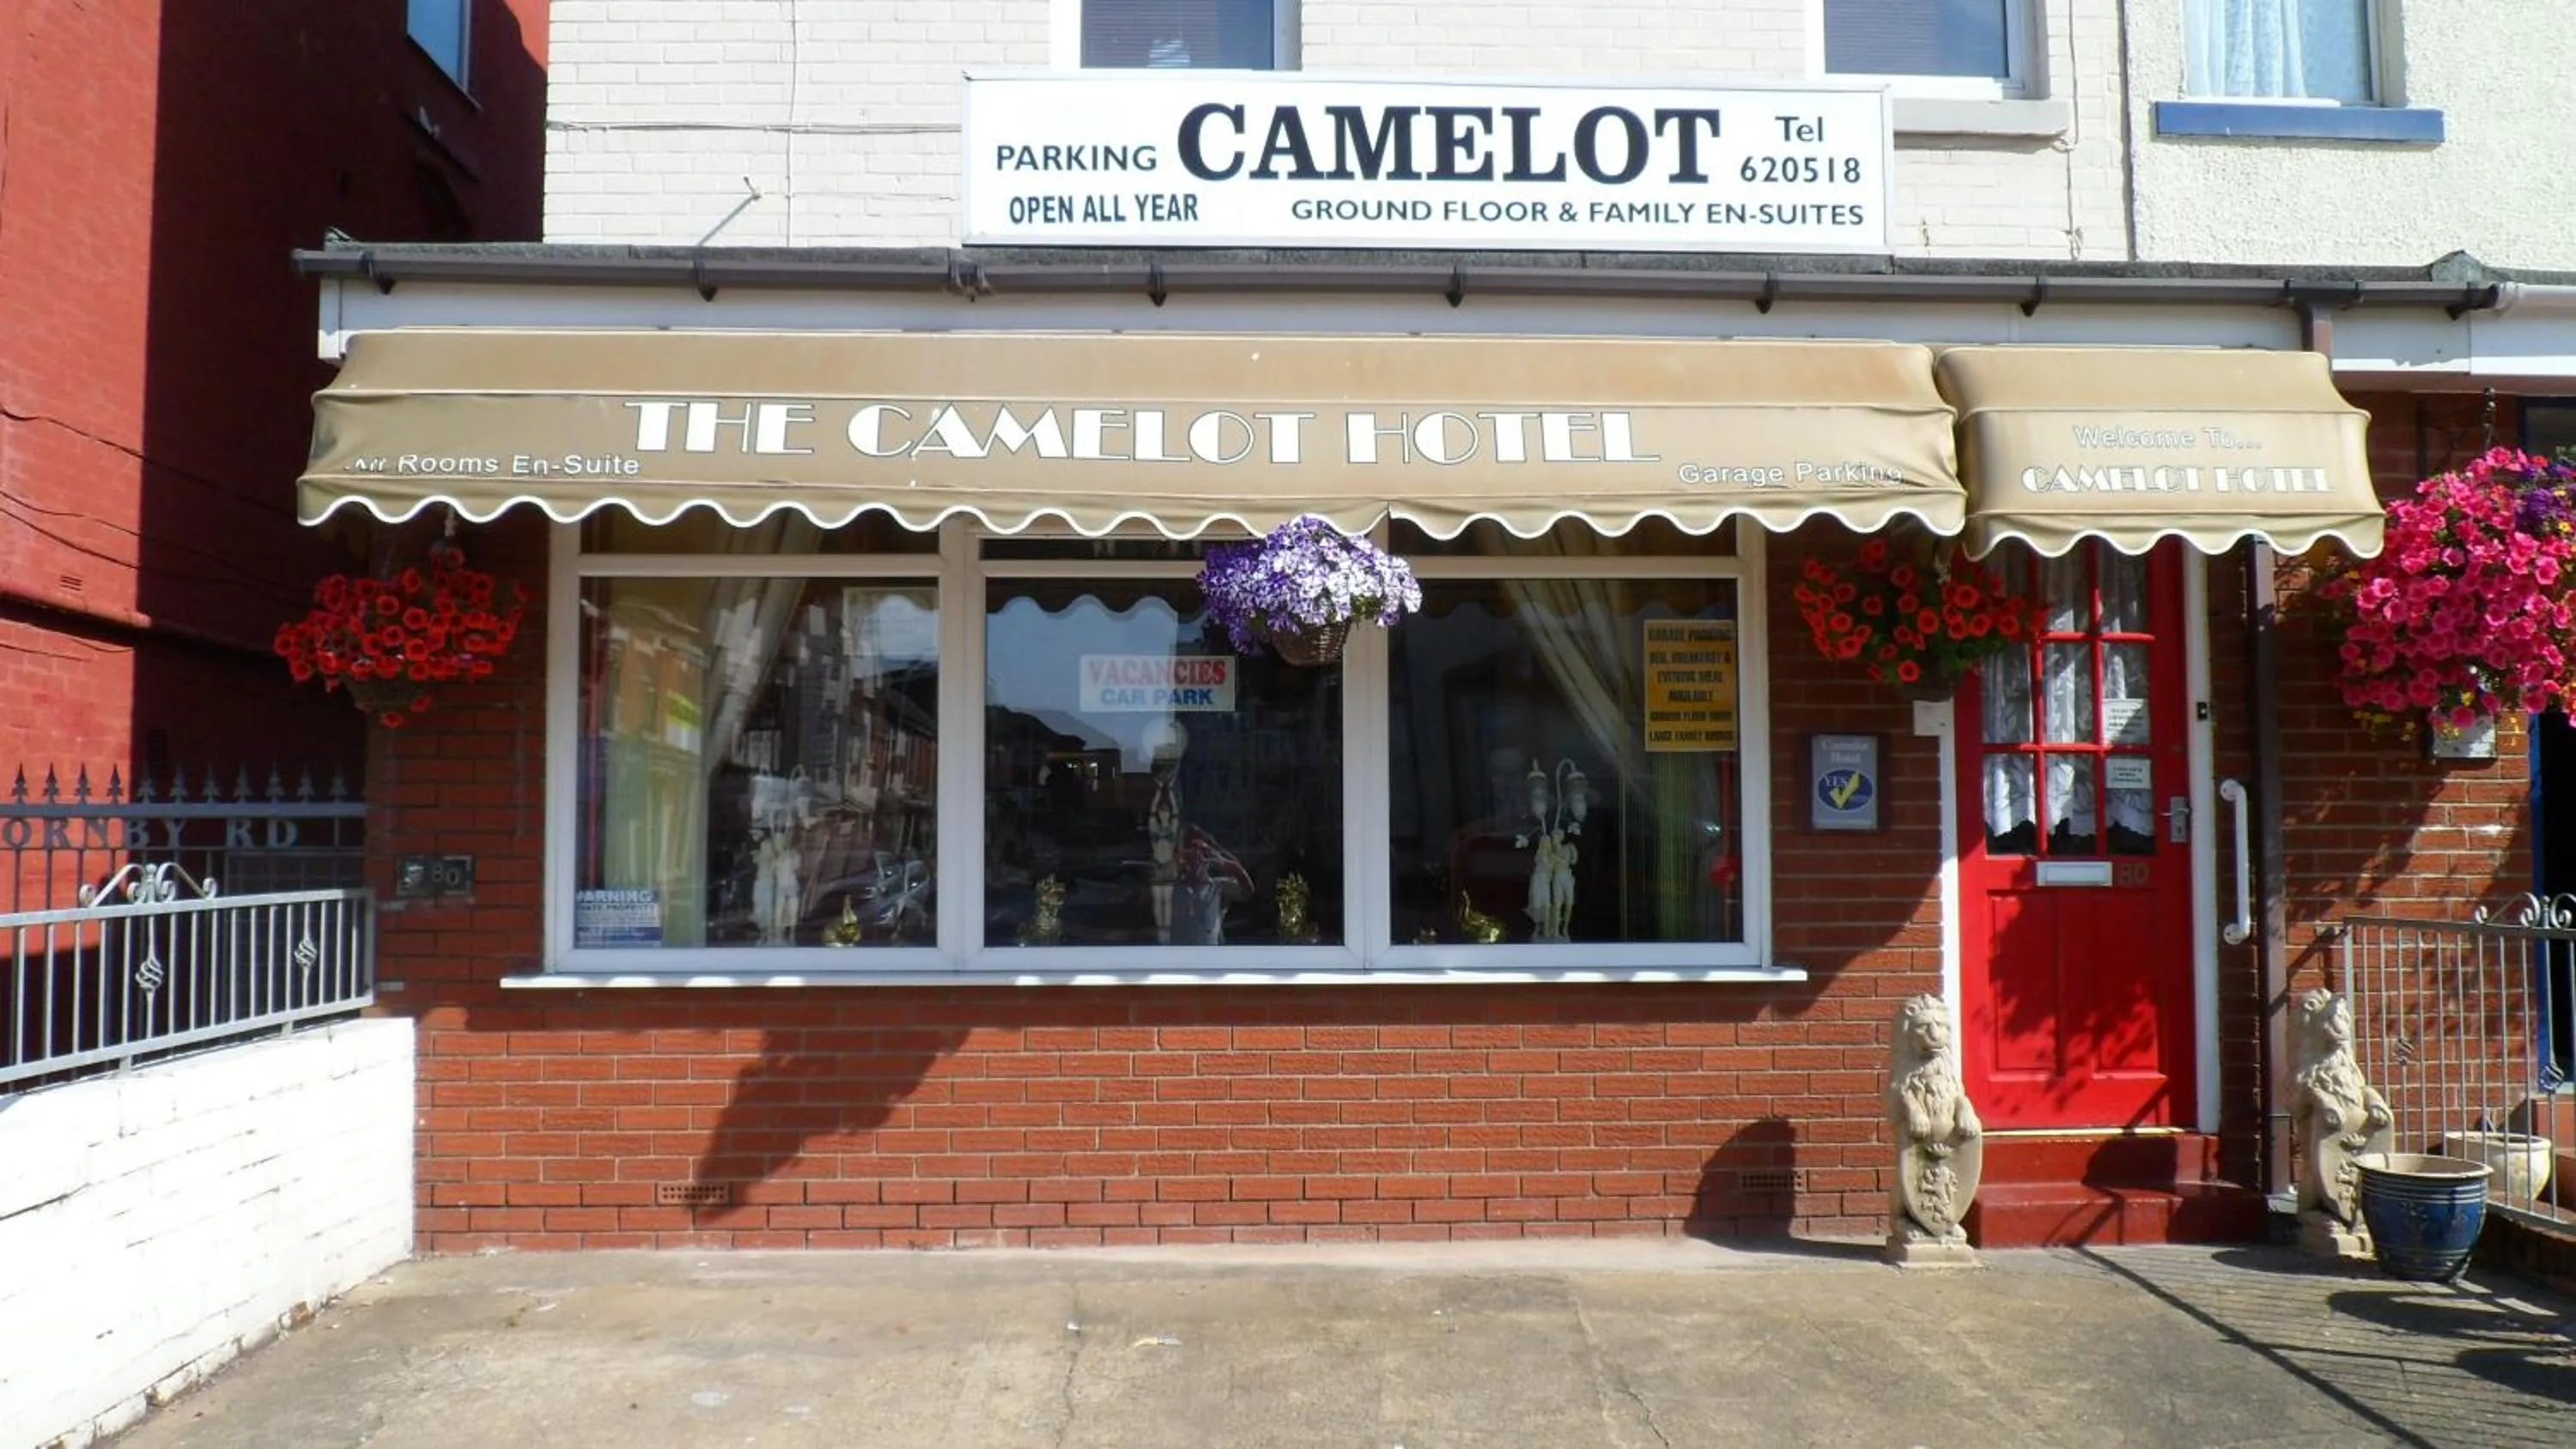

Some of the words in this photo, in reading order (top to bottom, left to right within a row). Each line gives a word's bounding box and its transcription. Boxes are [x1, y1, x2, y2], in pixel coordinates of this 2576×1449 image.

[1776, 116, 1824, 142] Tel
[1178, 102, 1720, 184] CAMELOT
[997, 145, 1157, 171] PARKING
[1741, 156, 1861, 183] 620518
[1010, 196, 1072, 224] OPEN
[1084, 194, 1126, 222] ALL
[1135, 192, 1199, 221] YEAR
[1292, 200, 1431, 221] GROUND
[1444, 202, 1548, 221] FLOOR
[1559, 202, 1578, 221] &
[1590, 202, 1696, 224] FAMILY
[1708, 203, 1864, 226] EN-SUITES
[624, 402, 815, 453] THE
[848, 403, 1315, 464] CAMELOT
[1347, 411, 1661, 464] HOTEL
[2073, 425, 2195, 449] Welcome
[398, 454, 498, 474] Rooms
[513, 454, 641, 476] En-Suite
[1678, 464, 1784, 487] Garage
[2020, 464, 2204, 493] CAMELOT
[2215, 465, 2336, 494] HOTEL
[1089, 659, 1226, 685] VACANCIES
[1101, 689, 1145, 705] CAR
[1154, 689, 1213, 705] PARK
[226, 817, 298, 849] RD
